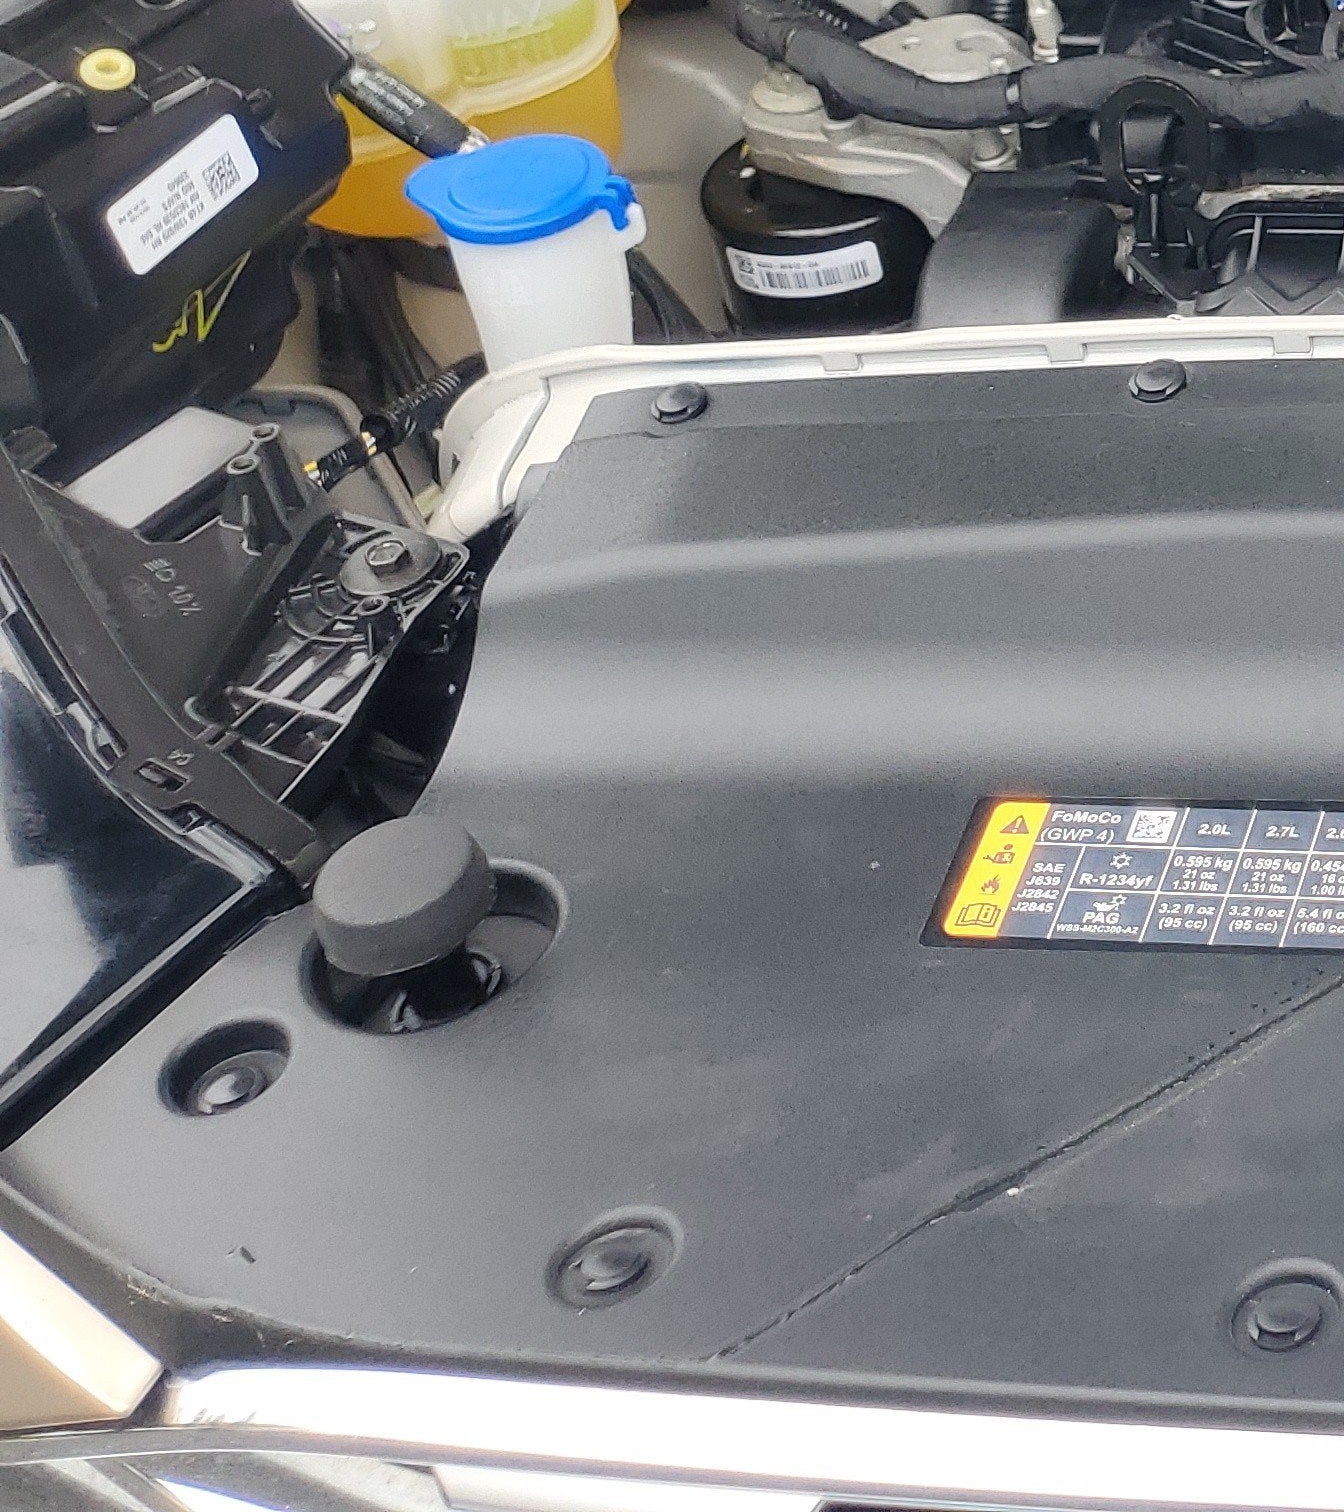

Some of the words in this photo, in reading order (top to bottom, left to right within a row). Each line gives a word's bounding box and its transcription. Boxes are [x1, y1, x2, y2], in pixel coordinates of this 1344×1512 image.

[1051, 810, 1122, 824] FoMoCo
[1197, 823, 1231, 836] 2.0L
[1265, 825, 1299, 838] 2.7L
[1040, 828, 1094, 842] (GWP
[1096, 829, 1115, 845] 4)
[1032, 862, 1066, 873] SAE
[1173, 855, 1213, 868] 0.595
[1214, 856, 1233, 872] kg
[1242, 857, 1282, 870] 0.595
[1283, 858, 1302, 874] kg
[1025, 875, 1061, 886] J639
[1182, 869, 1198, 879] 21
[1200, 871, 1216, 880] oz
[1251, 872, 1267, 882] 21
[1269, 874, 1285, 883] oz
[1321, 874, 1335, 884] 16
[1078, 873, 1154, 890] R-1234yf
[1172, 880, 1197, 890] 1.31
[1198, 881, 1219, 892] lbs
[1241, 882, 1267, 893] 1.31
[1268, 884, 1288, 894] lbs
[1016, 888, 1060, 900] J2842
[1311, 885, 1335, 896] 1.00
[1011, 900, 1055, 913] J2845
[1158, 903, 1182, 915] 3.2
[1183, 903, 1195, 916] fl
[1196, 905, 1216, 916] oz
[1228, 905, 1252, 918] 3.2
[1253, 906, 1265, 918] fl
[1266, 908, 1286, 918] oz
[1082, 911, 1120, 925] PAG
[1296, 907, 1321, 919] 5.4
[1322, 908, 1333, 920] fl
[1158, 917, 1183, 930] (95
[1184, 918, 1208, 932] cc)
[1228, 919, 1253, 933] (95
[1254, 920, 1278, 934] cc)
[1293, 921, 1327, 935] (160
